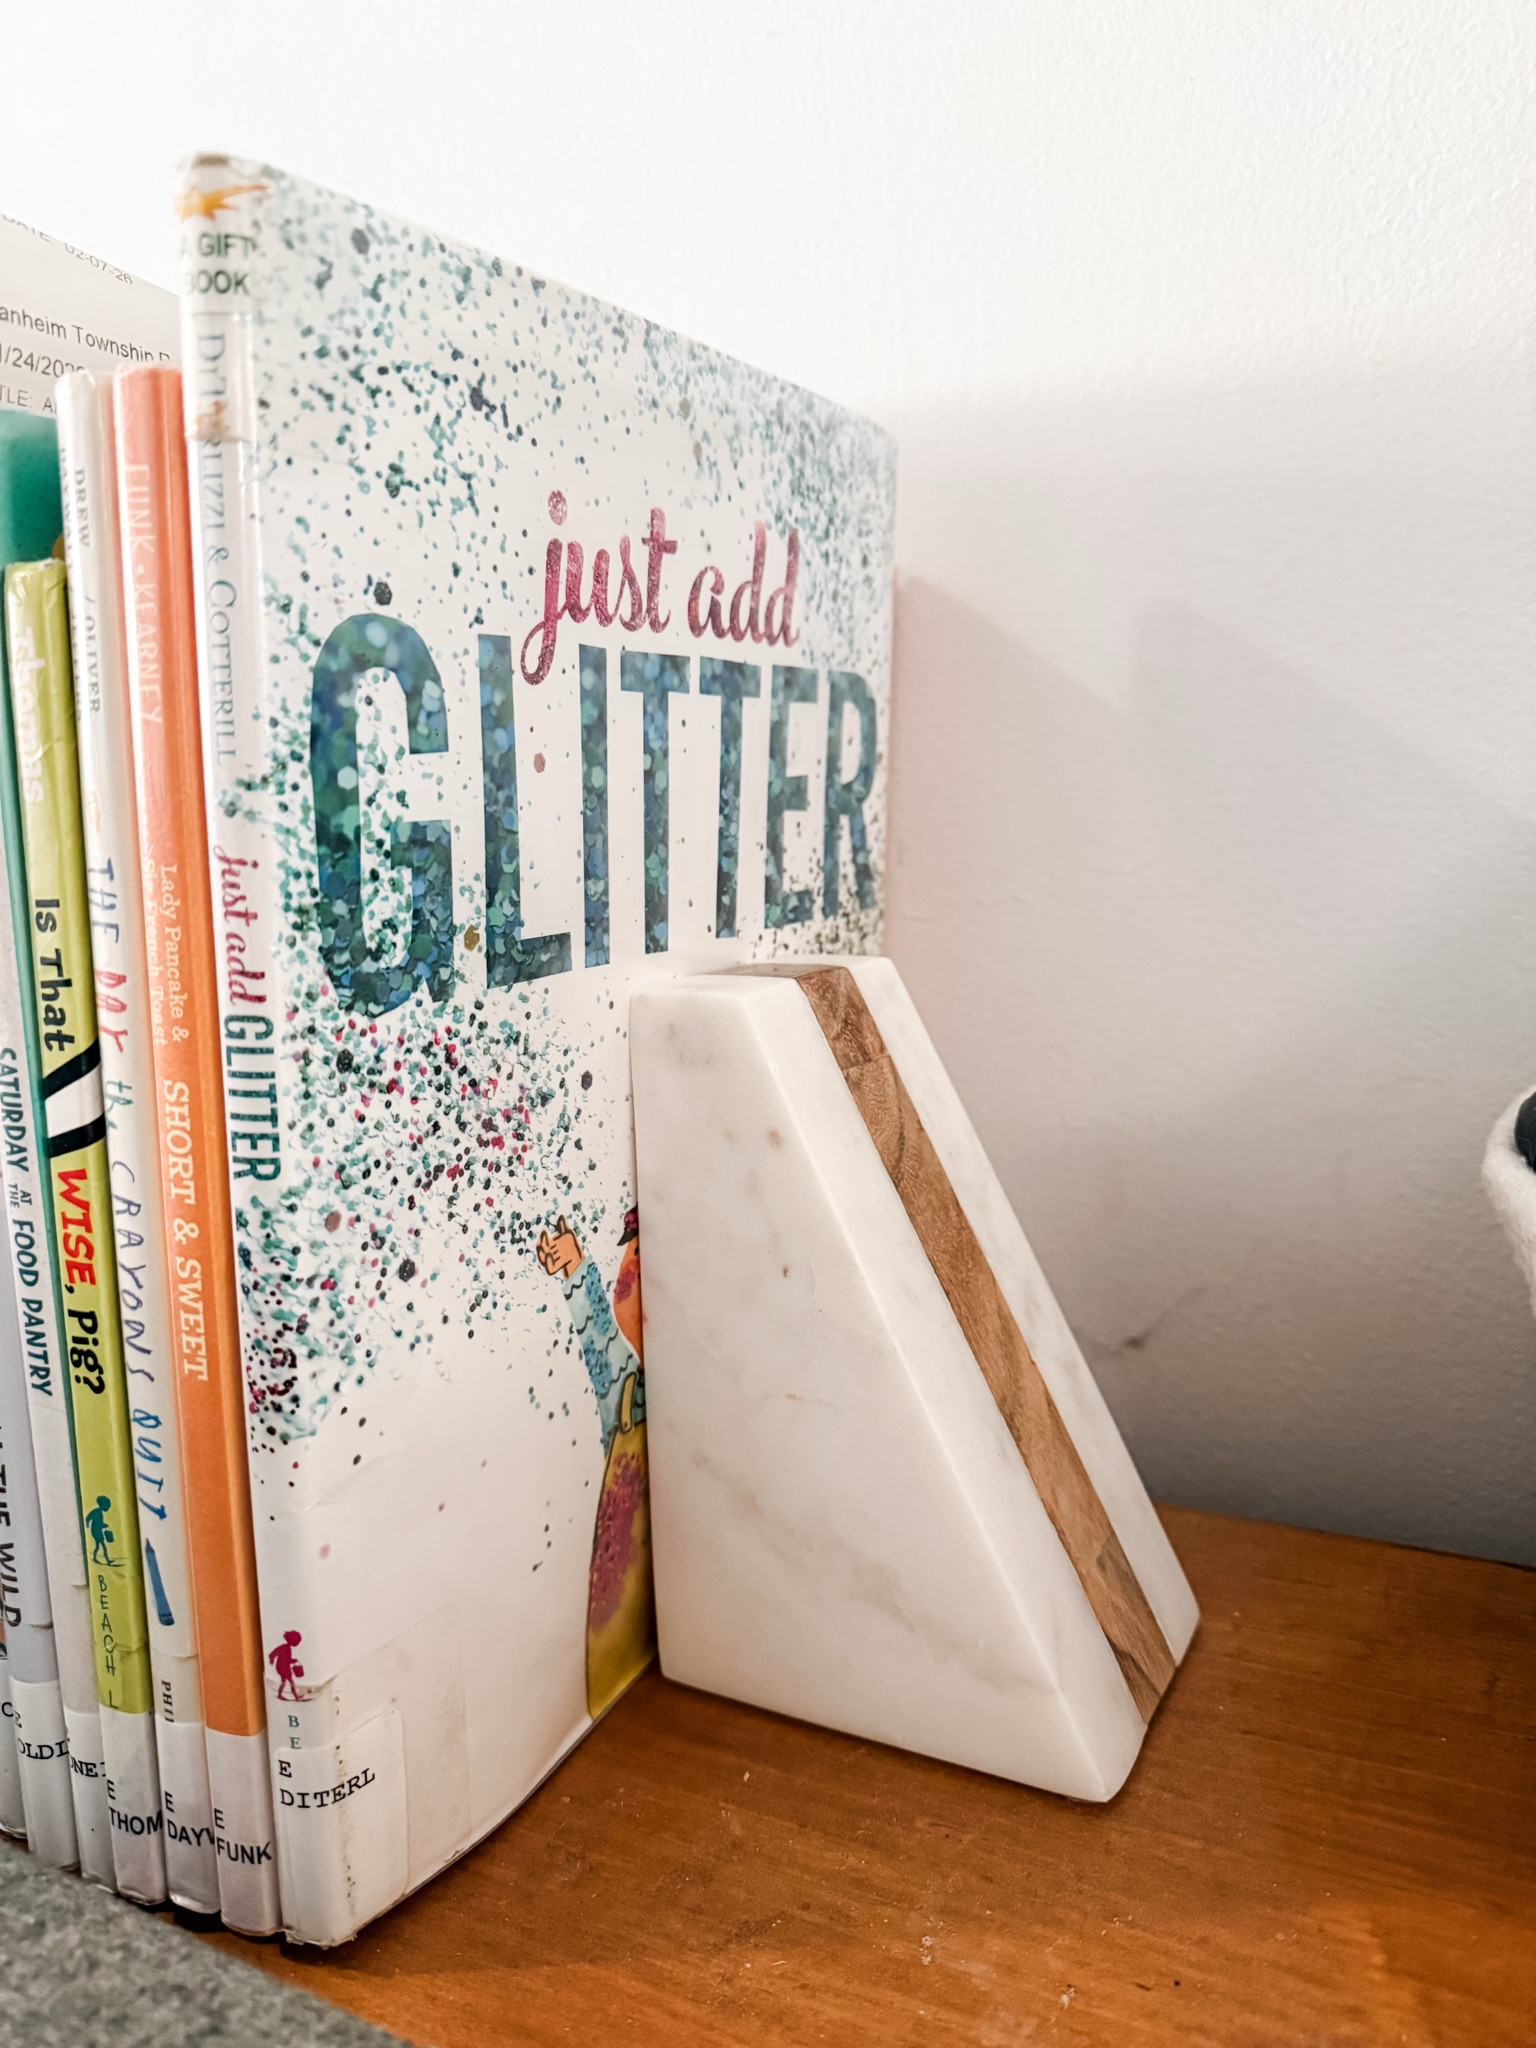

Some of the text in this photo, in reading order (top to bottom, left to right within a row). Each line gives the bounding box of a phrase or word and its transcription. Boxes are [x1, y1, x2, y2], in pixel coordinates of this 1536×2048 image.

[198, 233, 251, 258] GIFT
[75, 469, 91, 548] DREW
[125, 463, 164, 725] FUNK KEARNEY
[208, 546, 229, 563] &
[521, 490, 801, 686] just add
[85, 615, 100, 713] OLIVER
[310, 612, 879, 1018] GLITTER
[88, 858, 119, 944] THE
[160, 865, 190, 1042] Lady Pancake &
[39, 948, 75, 1052] That
[96, 970, 129, 1053] DAY
[151, 986, 168, 1047] Toast
[212, 845, 281, 1182] just add GLITTER
[8, 1183, 20, 1208] THE
[19, 1189, 32, 1206] AT
[57, 1168, 97, 1295] WISE,
[163, 1079, 208, 1382] SHORT & SWEET
[13, 1219, 39, 1288] FOOD
[111, 1160, 156, 1383] CRAYONS
[21, 1298, 53, 1397] PANTRY
[67, 1308, 106, 1395] Pig?
[131, 1407, 168, 1520] QUIT
[107, 1778, 116, 1801] E
[164, 1790, 175, 1813] E
[278, 1759, 292, 1779] E
[280, 1767, 376, 1810] DITERL
[213, 1807, 226, 1830] E
[216, 1836, 273, 1866] FUNK
